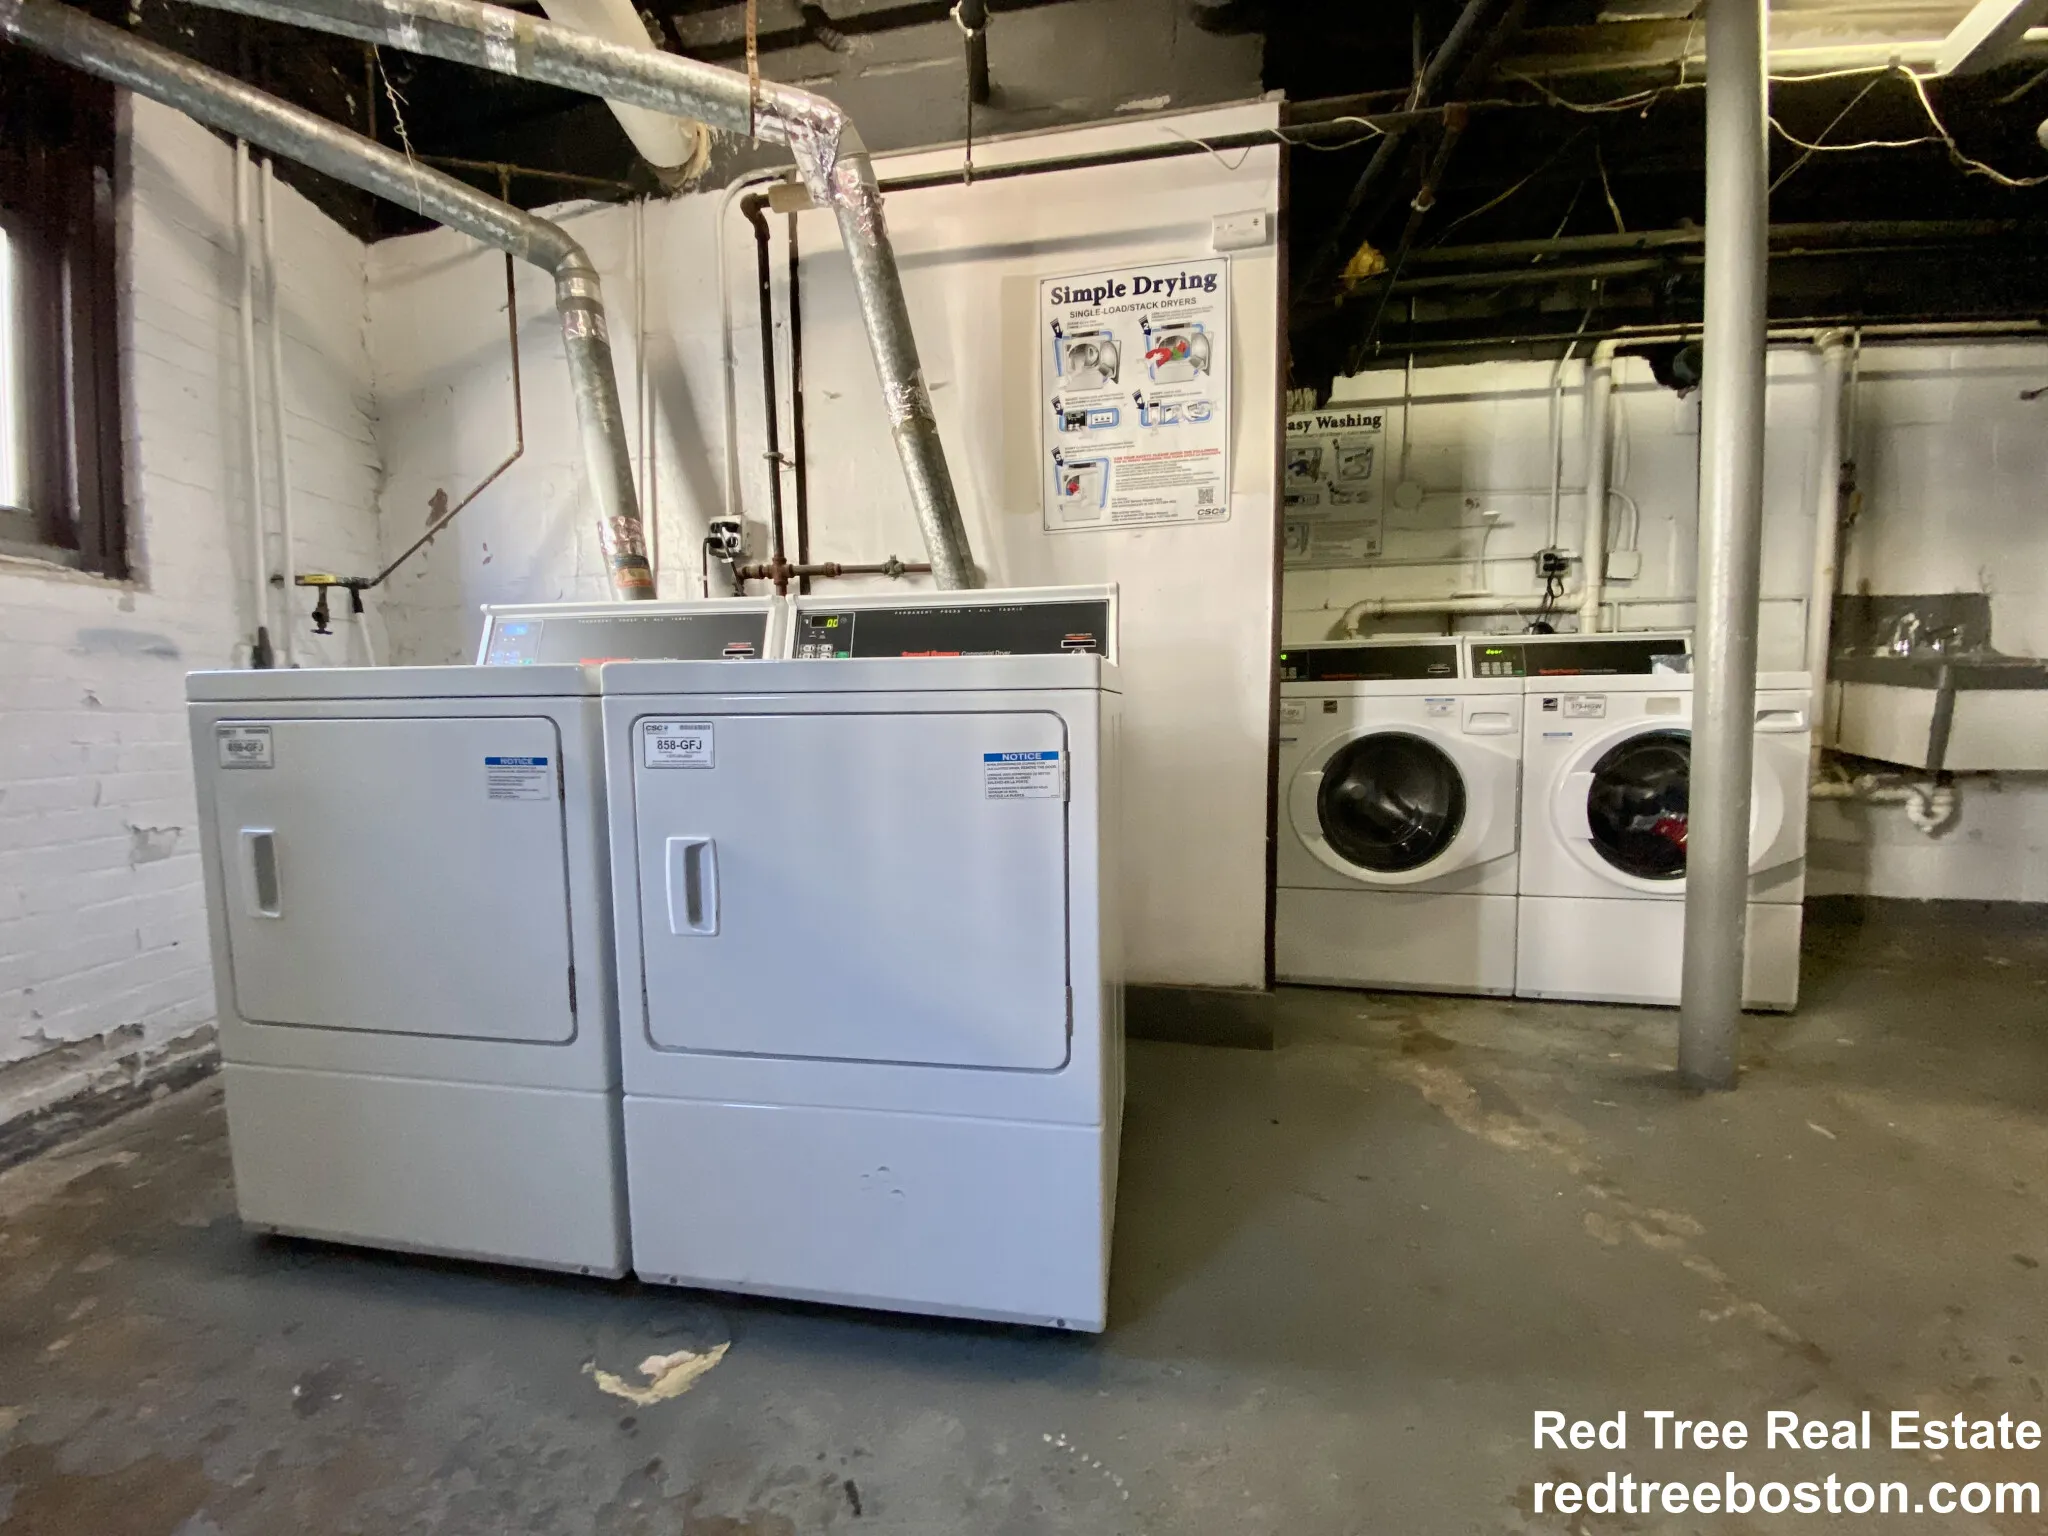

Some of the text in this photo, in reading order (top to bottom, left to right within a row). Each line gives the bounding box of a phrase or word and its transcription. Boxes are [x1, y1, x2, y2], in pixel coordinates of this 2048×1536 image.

[1050, 271, 1218, 306] Simple Drying
[1069, 301, 1159, 319] SINGLE-LOAD/STACK
[1160, 297, 1197, 309] DRYERS
[1316, 414, 1382, 429] Washing
[657, 740, 702, 750] 858-GFJ
[1002, 753, 1042, 761] NOTICE
